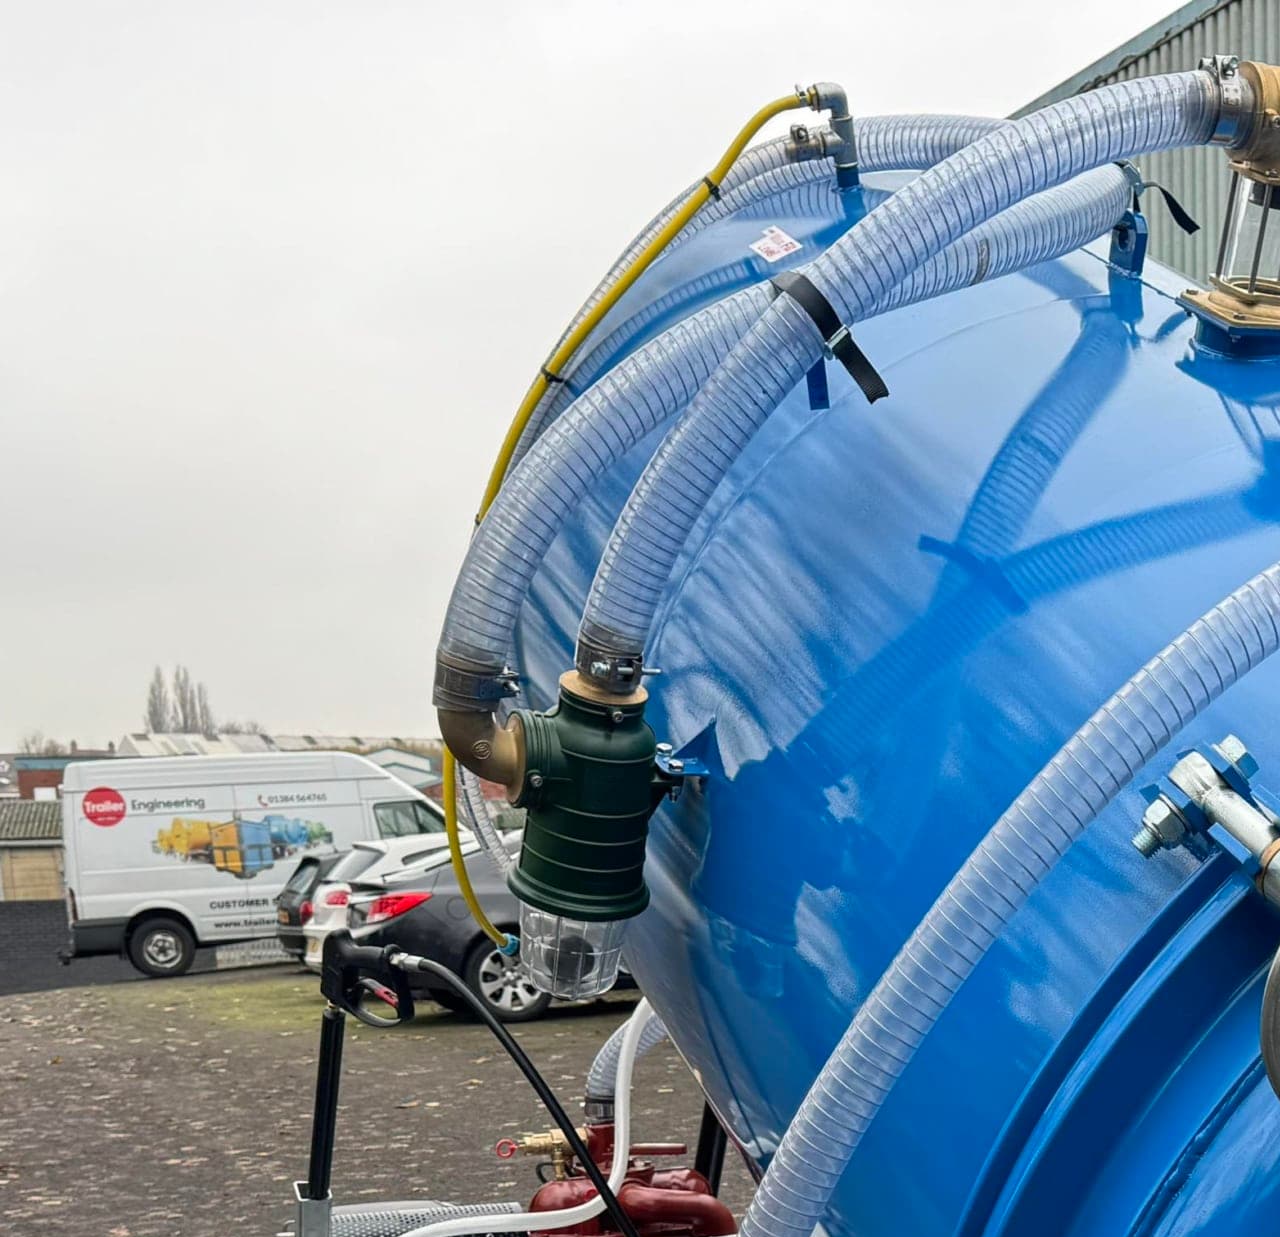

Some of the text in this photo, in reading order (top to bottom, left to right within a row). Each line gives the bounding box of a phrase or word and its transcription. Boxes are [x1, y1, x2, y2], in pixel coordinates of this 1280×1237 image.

[84, 797, 206, 813] Trailer Engineering
[209, 898, 269, 910] CUSTOMER
[214, 918, 277, 929] www.trailer
